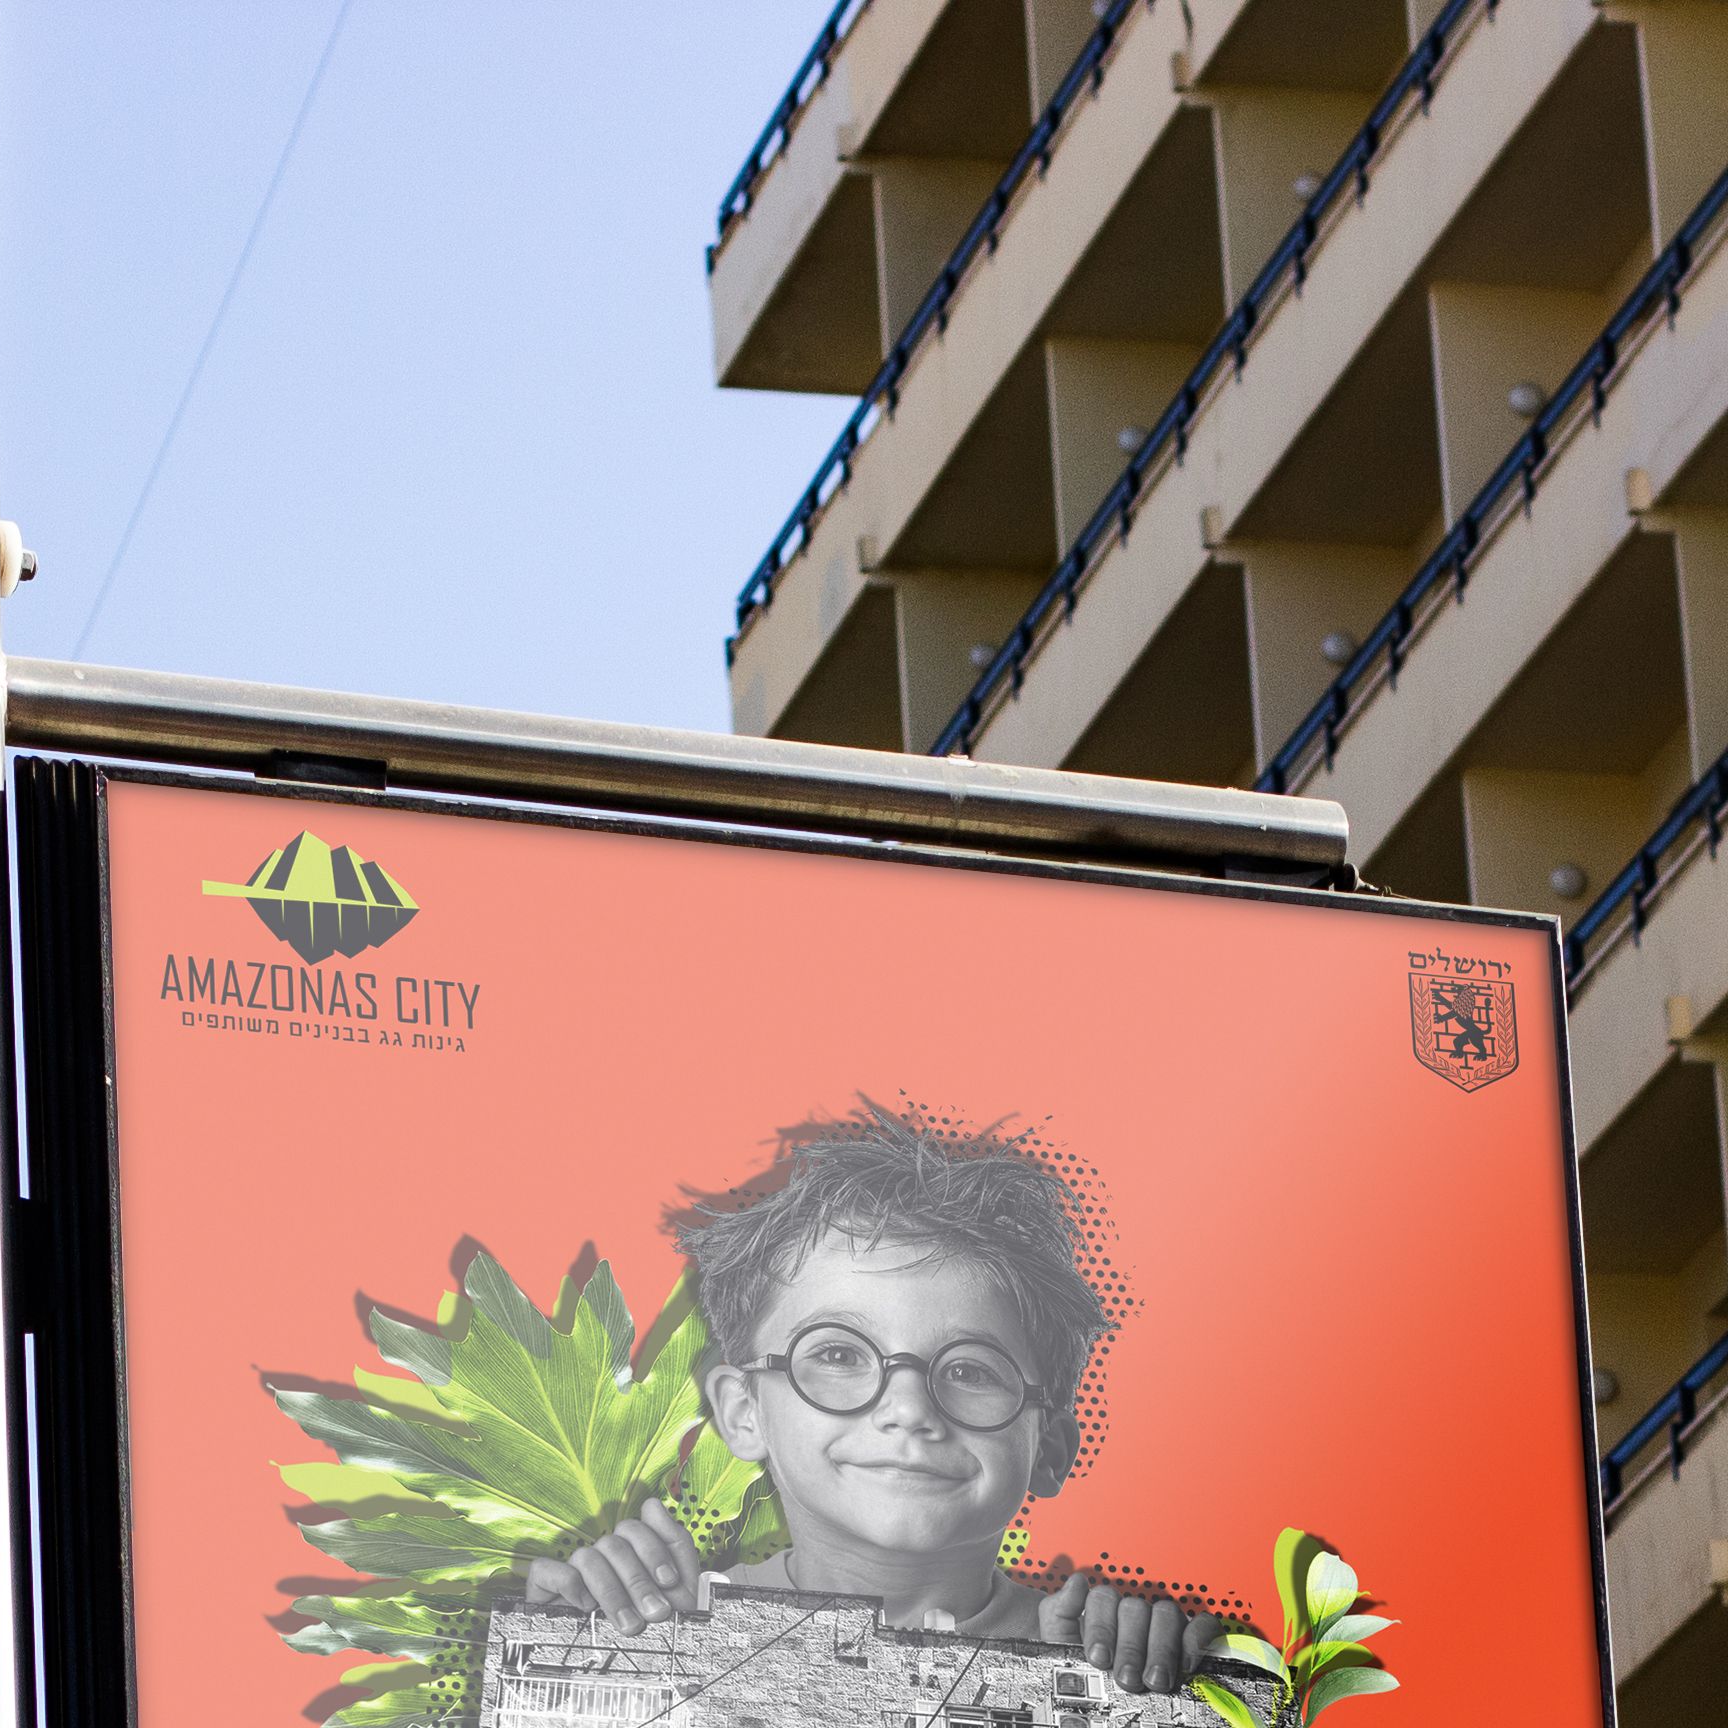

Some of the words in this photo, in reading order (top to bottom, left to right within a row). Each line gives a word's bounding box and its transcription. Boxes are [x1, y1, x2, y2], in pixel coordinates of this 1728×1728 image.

[1408, 947, 1512, 978] ירושלים
[161, 954, 378, 1020] AMAZONAS
[396, 977, 481, 1030] CITY
[182, 1011, 279, 1035] משותפים
[290, 1021, 370, 1044] בבנינים
[379, 1030, 403, 1047] גג
[412, 1033, 465, 1053] גינות
